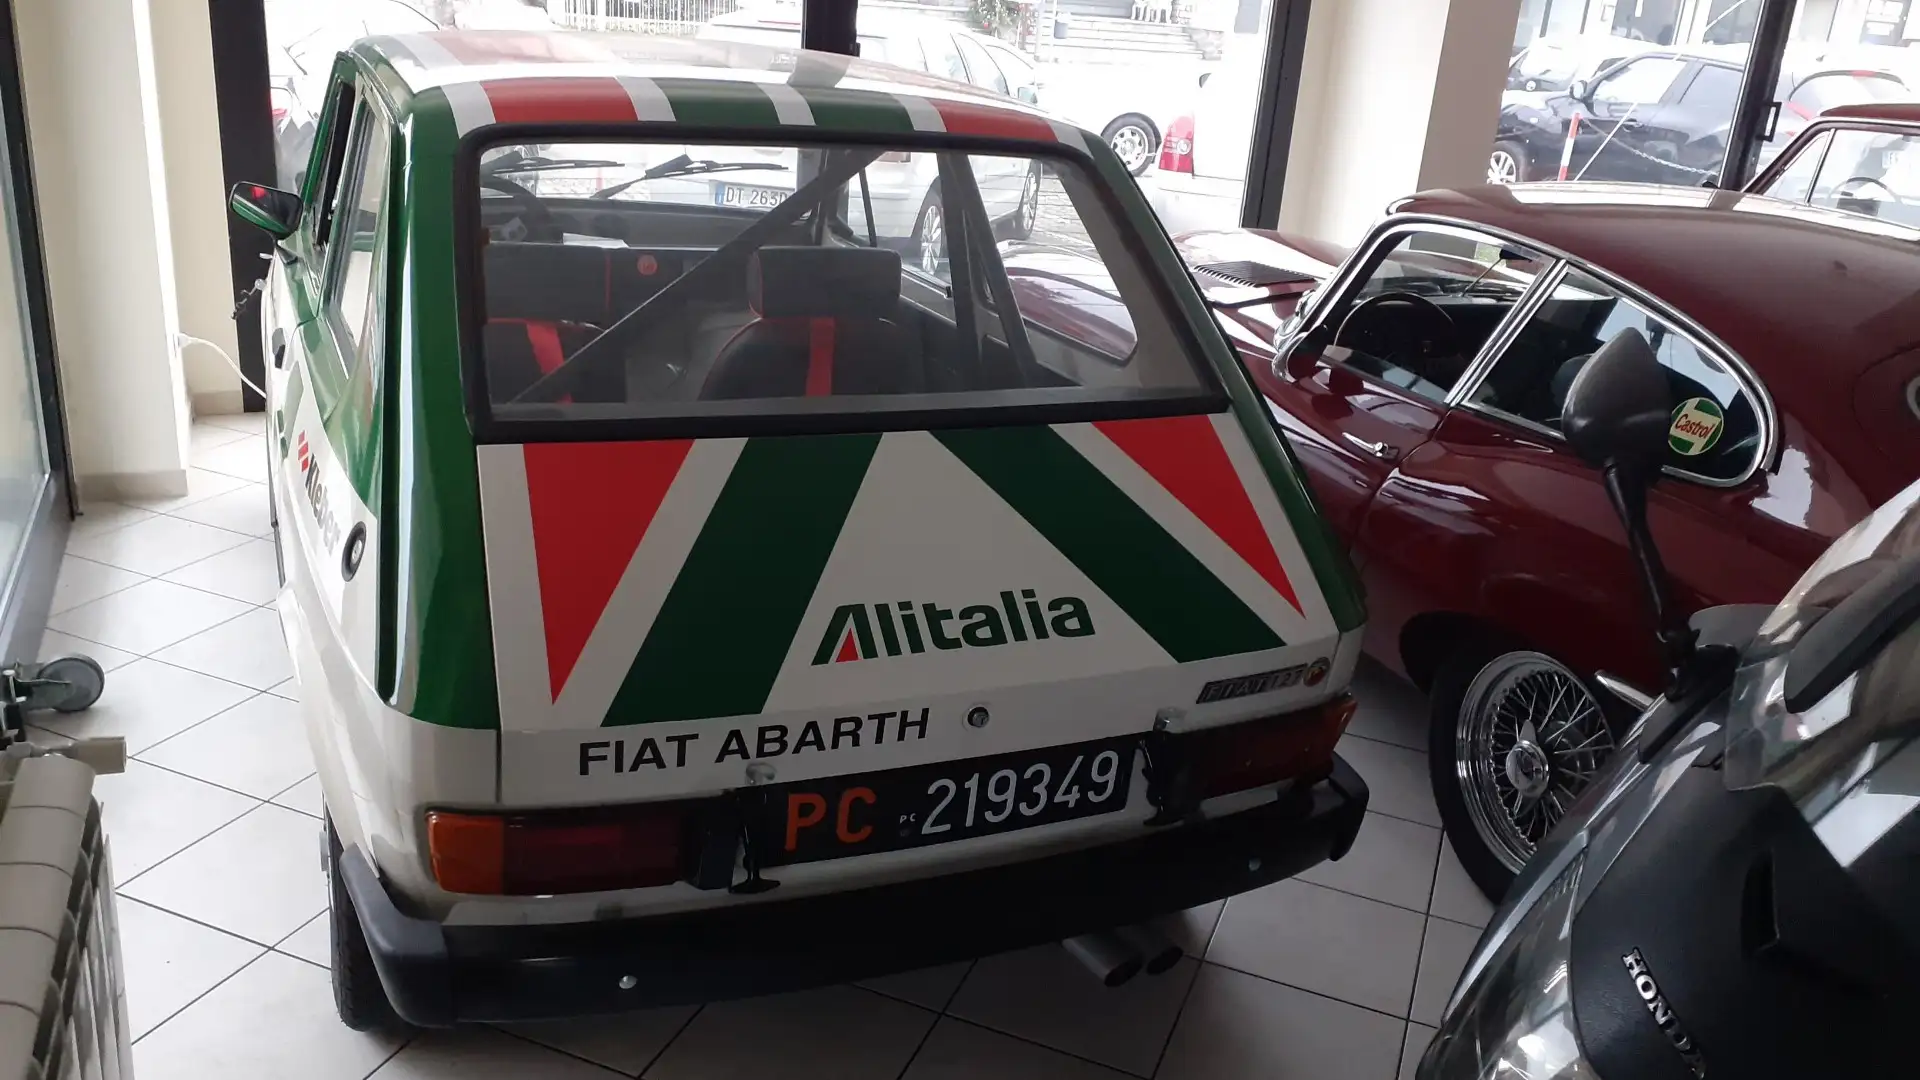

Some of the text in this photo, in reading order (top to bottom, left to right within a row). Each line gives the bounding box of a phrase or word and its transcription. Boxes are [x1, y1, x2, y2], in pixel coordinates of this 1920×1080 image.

[726, 187, 745, 204] DT
[1675, 413, 1715, 439] Castrol
[305, 453, 341, 557] Kleber
[811, 589, 1096, 666] Alitalia
[1205, 677, 1268, 700] FIAT
[579, 708, 930, 776] FIAT ABARTH
[784, 786, 877, 850] PC
[921, 750, 1119, 835] 219349
[1622, 948, 1706, 1079] HONDA
